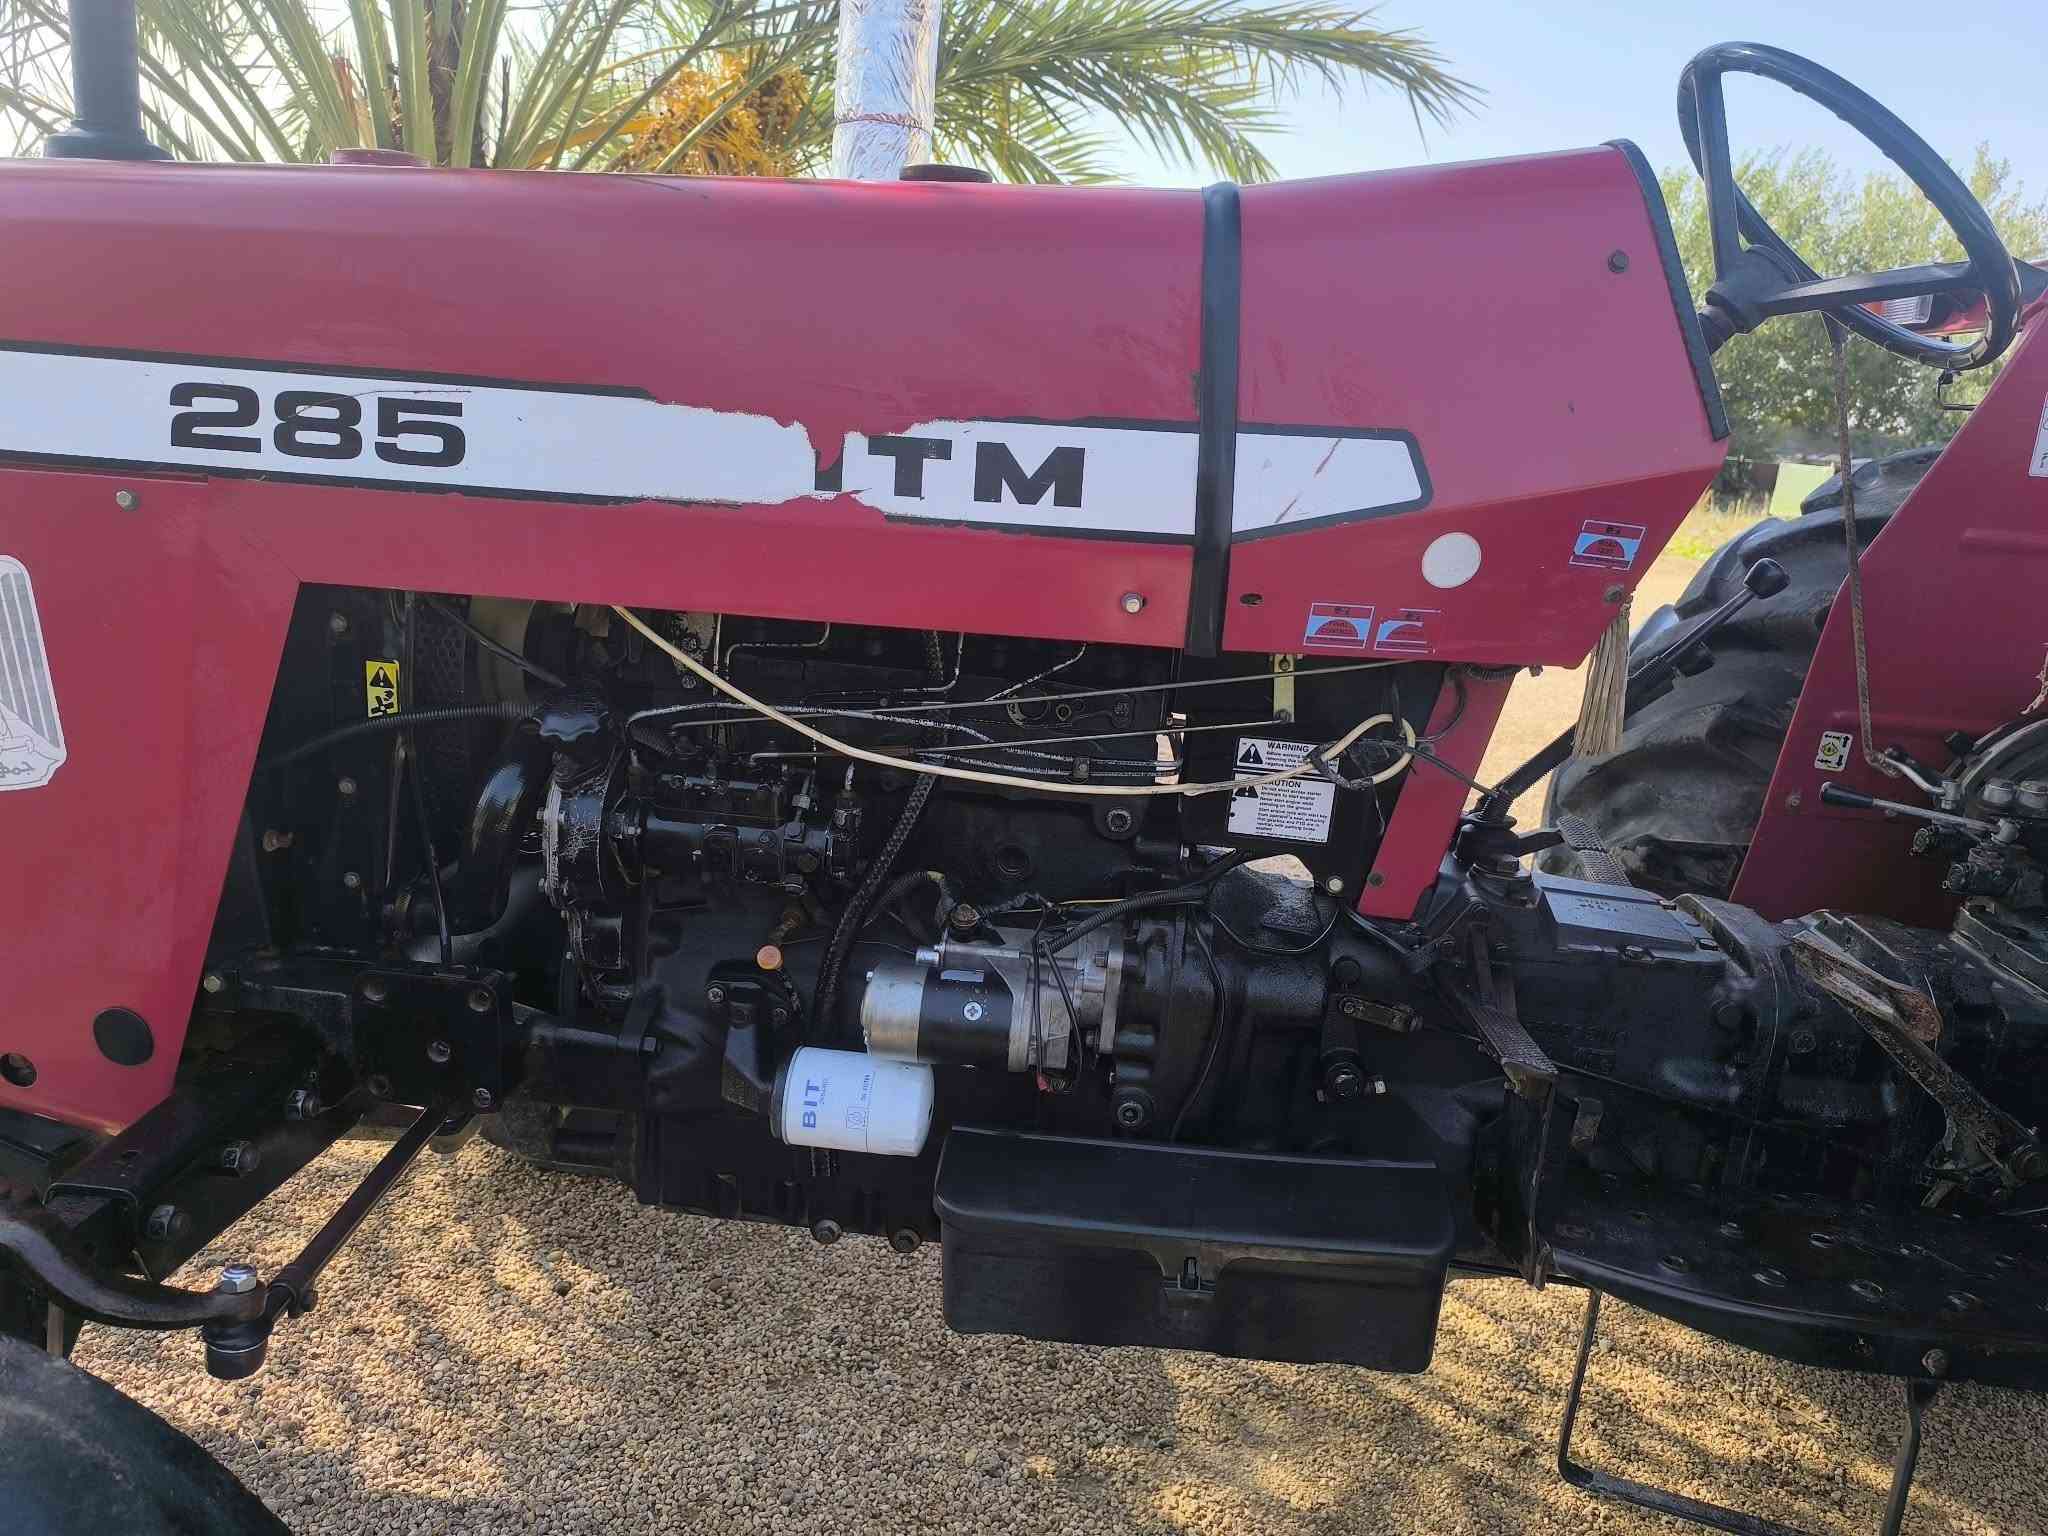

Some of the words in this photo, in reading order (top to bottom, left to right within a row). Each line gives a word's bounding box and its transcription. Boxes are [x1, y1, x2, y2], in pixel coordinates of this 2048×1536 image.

[169, 381, 467, 467] 285
[814, 435, 1085, 508] ITM
[1267, 742, 1310, 753] WARNING
[1264, 780, 1302, 788] UTION
[802, 1079, 819, 1129] BIT
